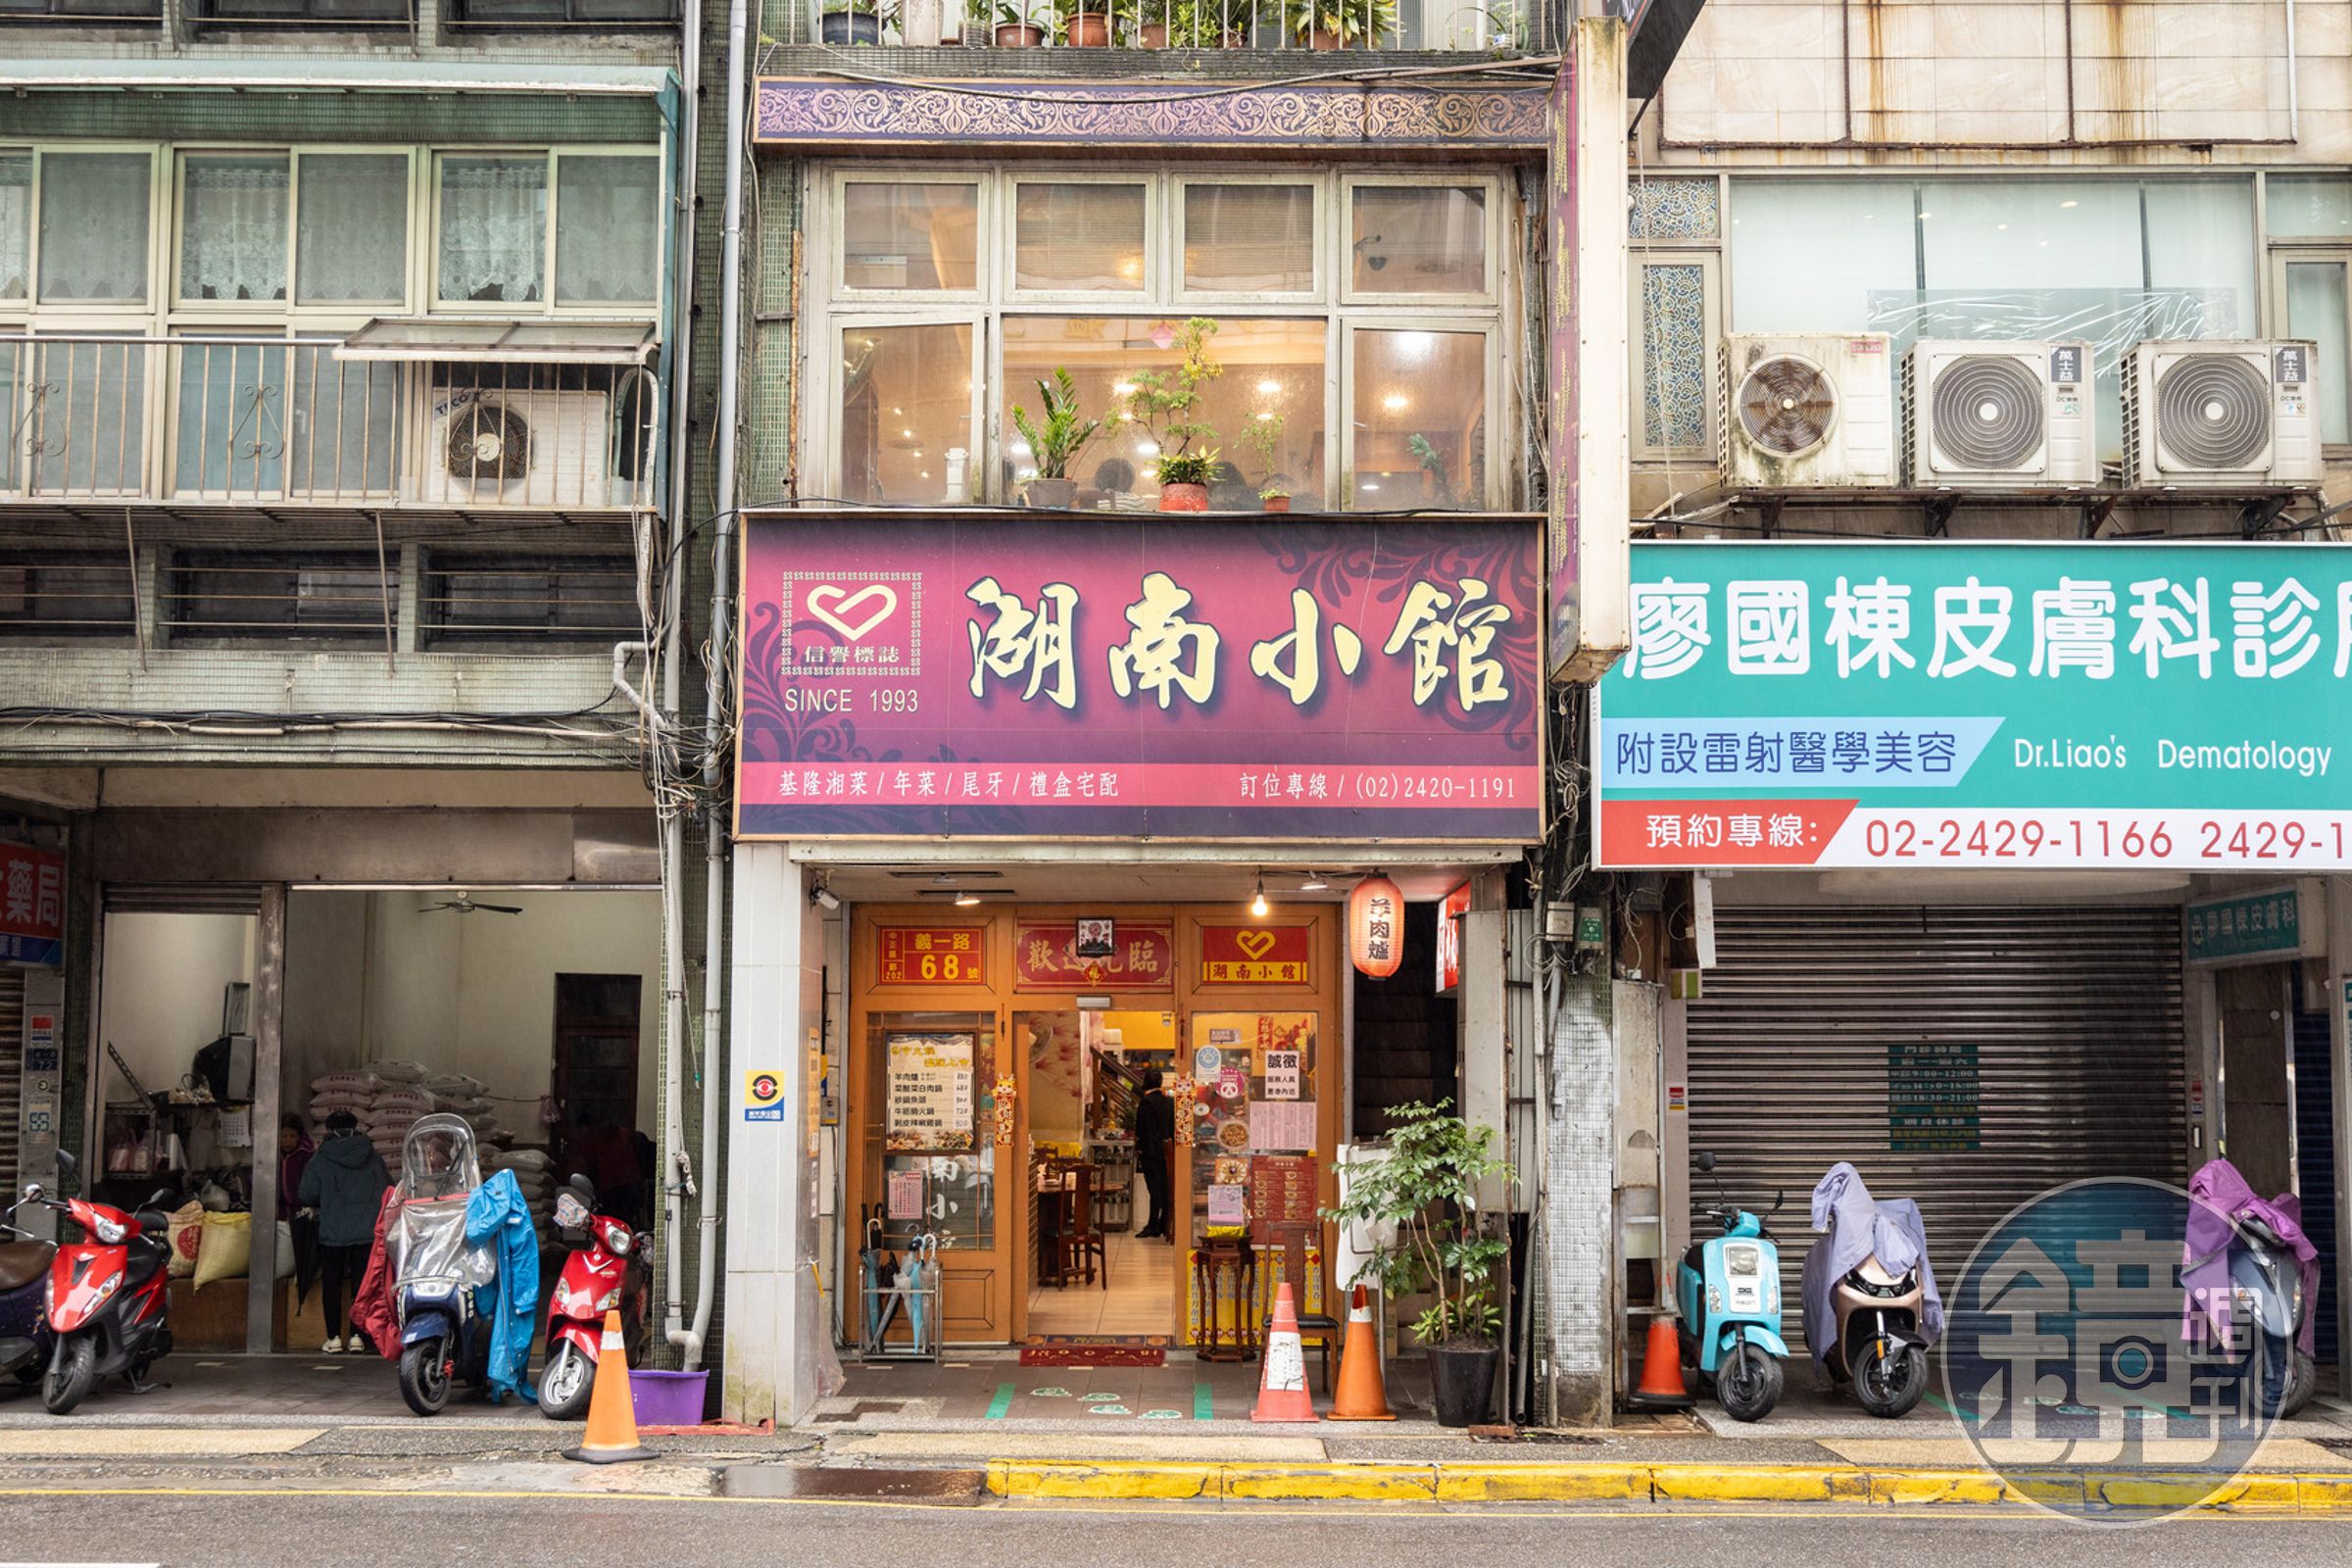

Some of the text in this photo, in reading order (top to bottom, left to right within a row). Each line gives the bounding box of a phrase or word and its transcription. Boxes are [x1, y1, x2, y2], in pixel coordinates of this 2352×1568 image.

[2058, 349, 2075, 382] 萬士益
[2282, 349, 2300, 382] 萬士益
[966, 569, 1515, 712] 湖南小館
[1623, 575, 2352, 680] 廖國棟皮膚科診
[803, 643, 902, 666] 信譽標誌
[785, 688, 920, 713] SINCE 1993
[1616, 731, 1958, 776] 附設雷射醫學美容
[2014, 734, 2332, 777] Dr.Liao's Dematology
[1865, 819, 2174, 859] 02-2429-1166
[0, 858, 60, 927] 藥局
[915, 933, 970, 951] 義一路
[1368, 898, 1392, 960] 羊肉爐
[921, 954, 959, 980] 68
[1026, 940, 1159, 974] 歡臨
[1213, 963, 1296, 980] 湖南小館
[1267, 1054, 1298, 1070] 誠徵
